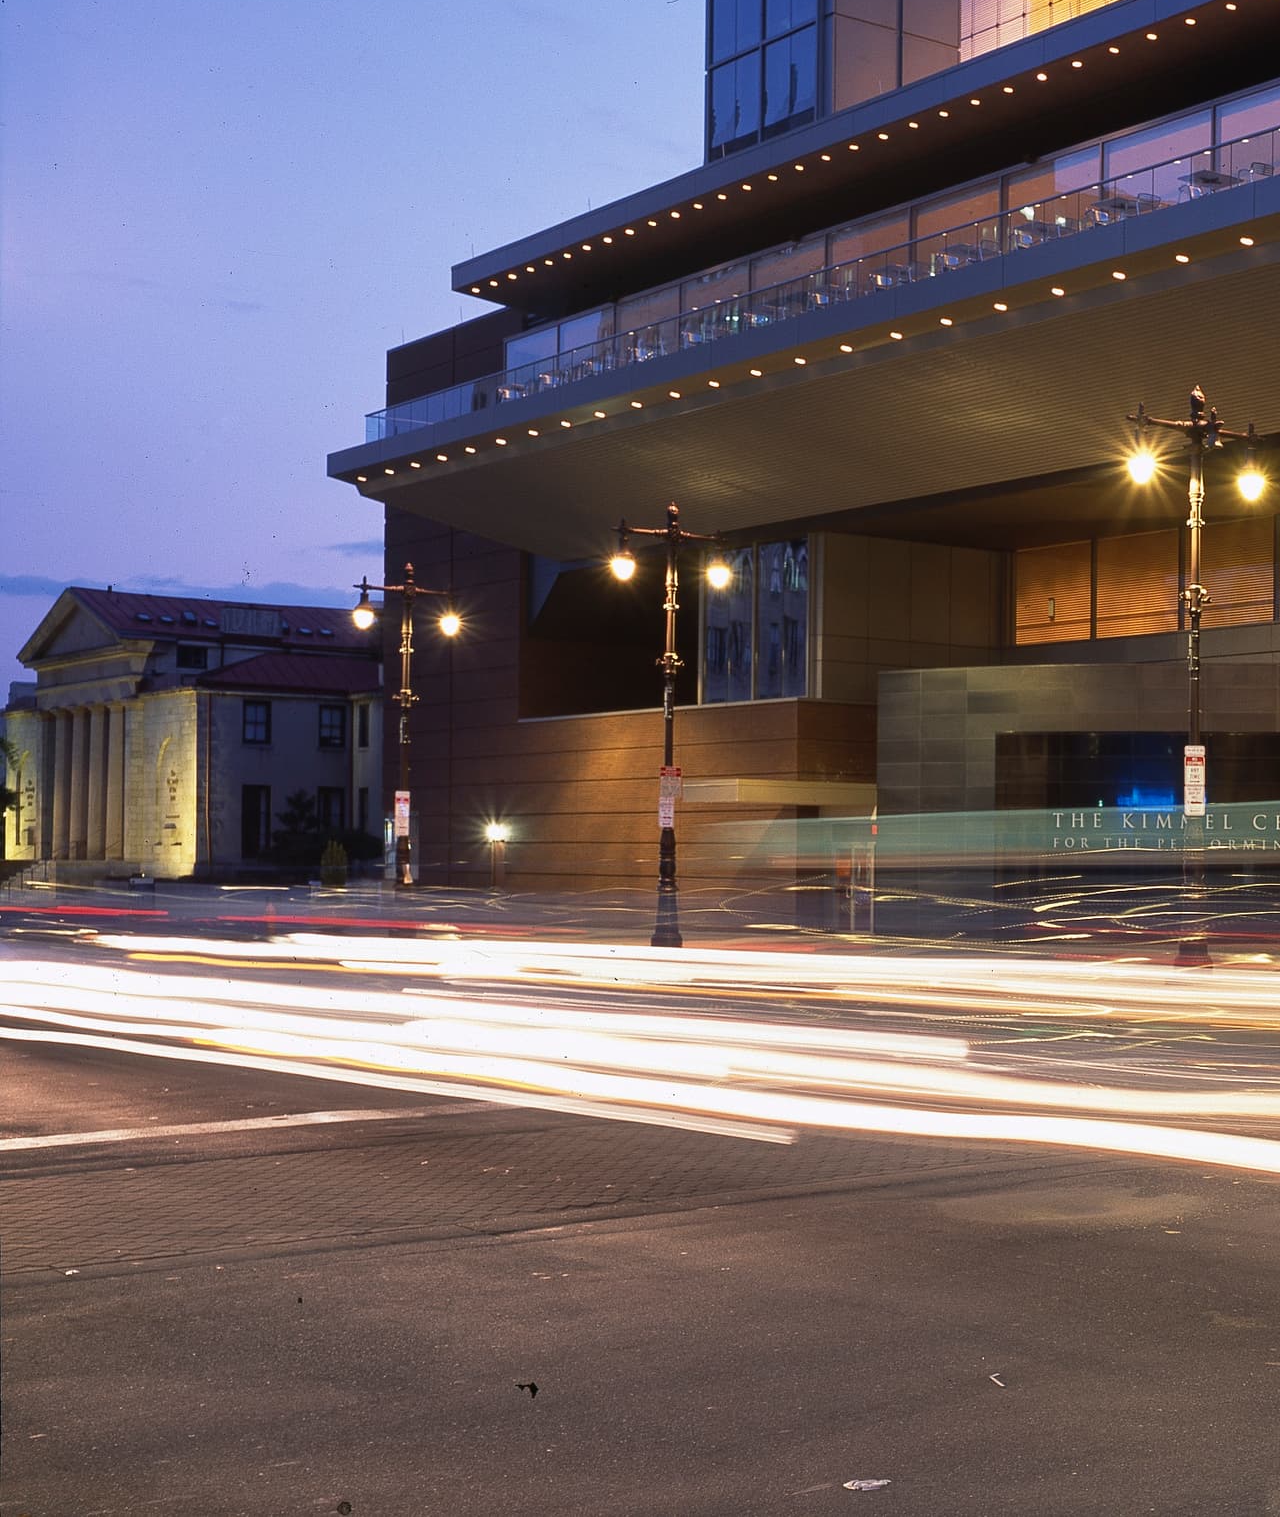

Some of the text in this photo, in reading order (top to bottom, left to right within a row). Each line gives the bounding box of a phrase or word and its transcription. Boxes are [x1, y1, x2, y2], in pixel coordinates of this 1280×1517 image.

[1052, 812, 1104, 829] THE
[1053, 837, 1089, 849] FOR
[1104, 837, 1141, 849] THE
